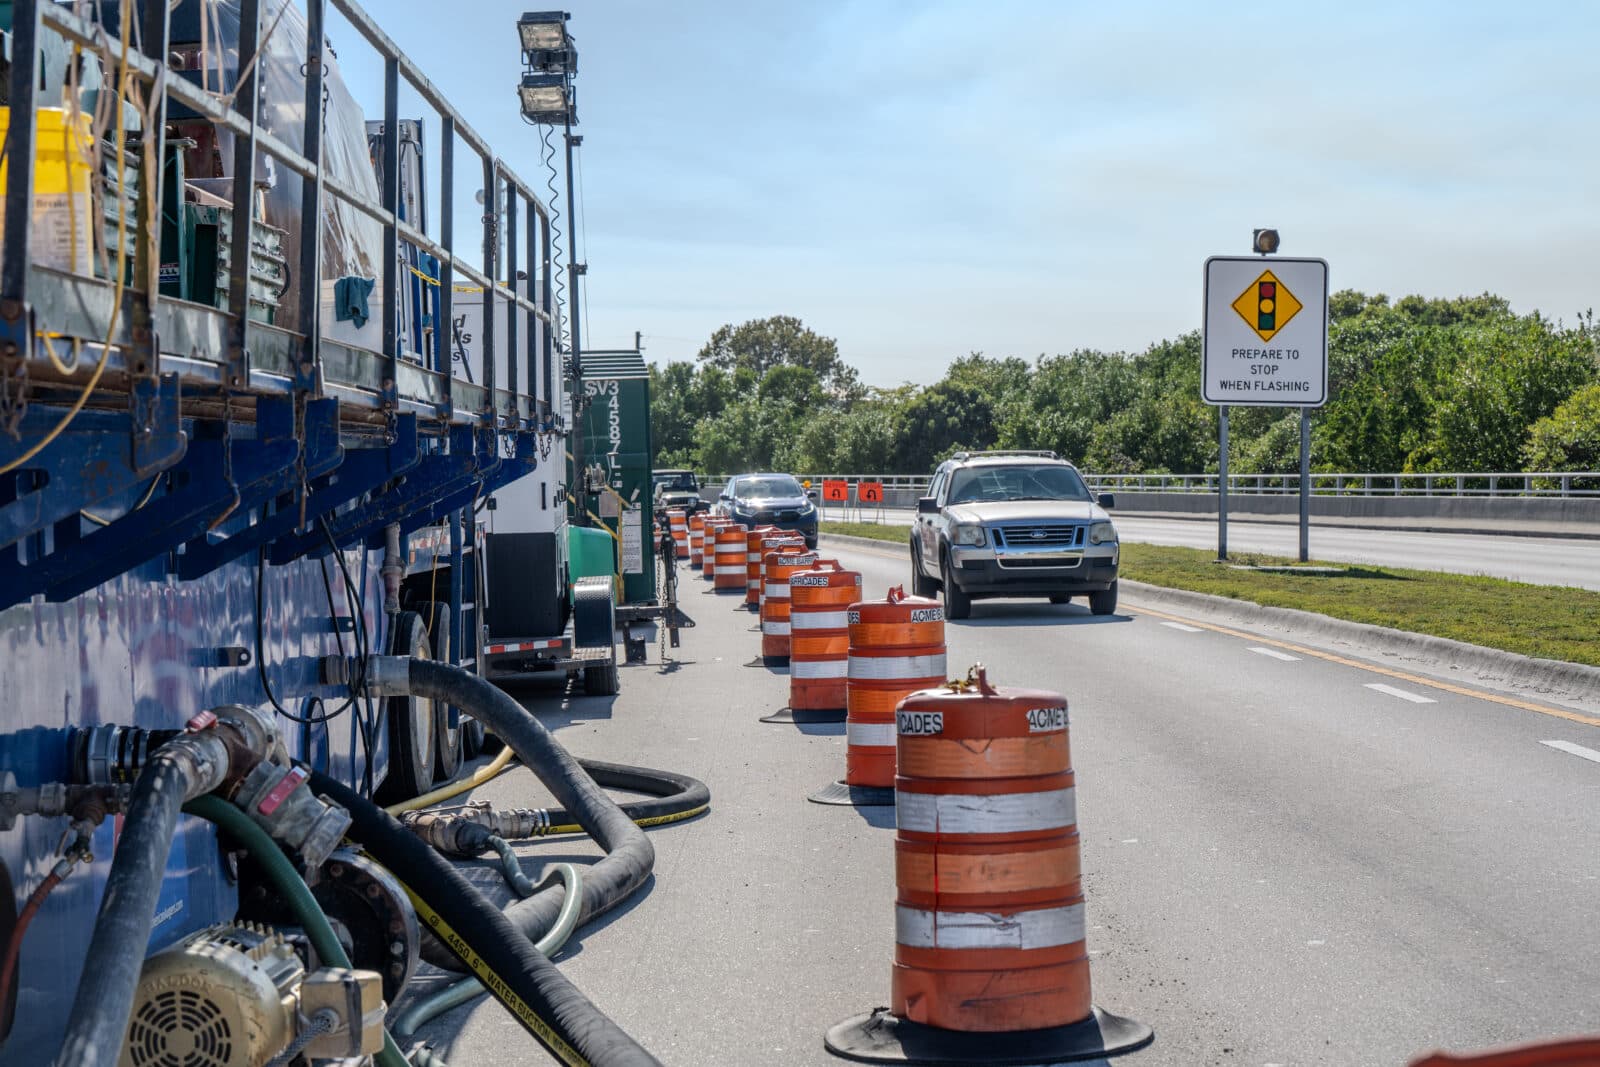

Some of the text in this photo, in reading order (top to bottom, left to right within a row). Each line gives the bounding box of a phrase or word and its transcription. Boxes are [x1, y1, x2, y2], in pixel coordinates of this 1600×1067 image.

[1231, 348, 1300, 360] PREPARE TO
[1250, 364, 1279, 375] STOP
[1219, 380, 1310, 392] WHEN FLASHING
[912, 609, 937, 622] ACME
[1029, 707, 1061, 728] ACME
[447, 933, 470, 959] 4450
[487, 970, 517, 1007] WATER
[517, 1002, 551, 1041] SUCTION
